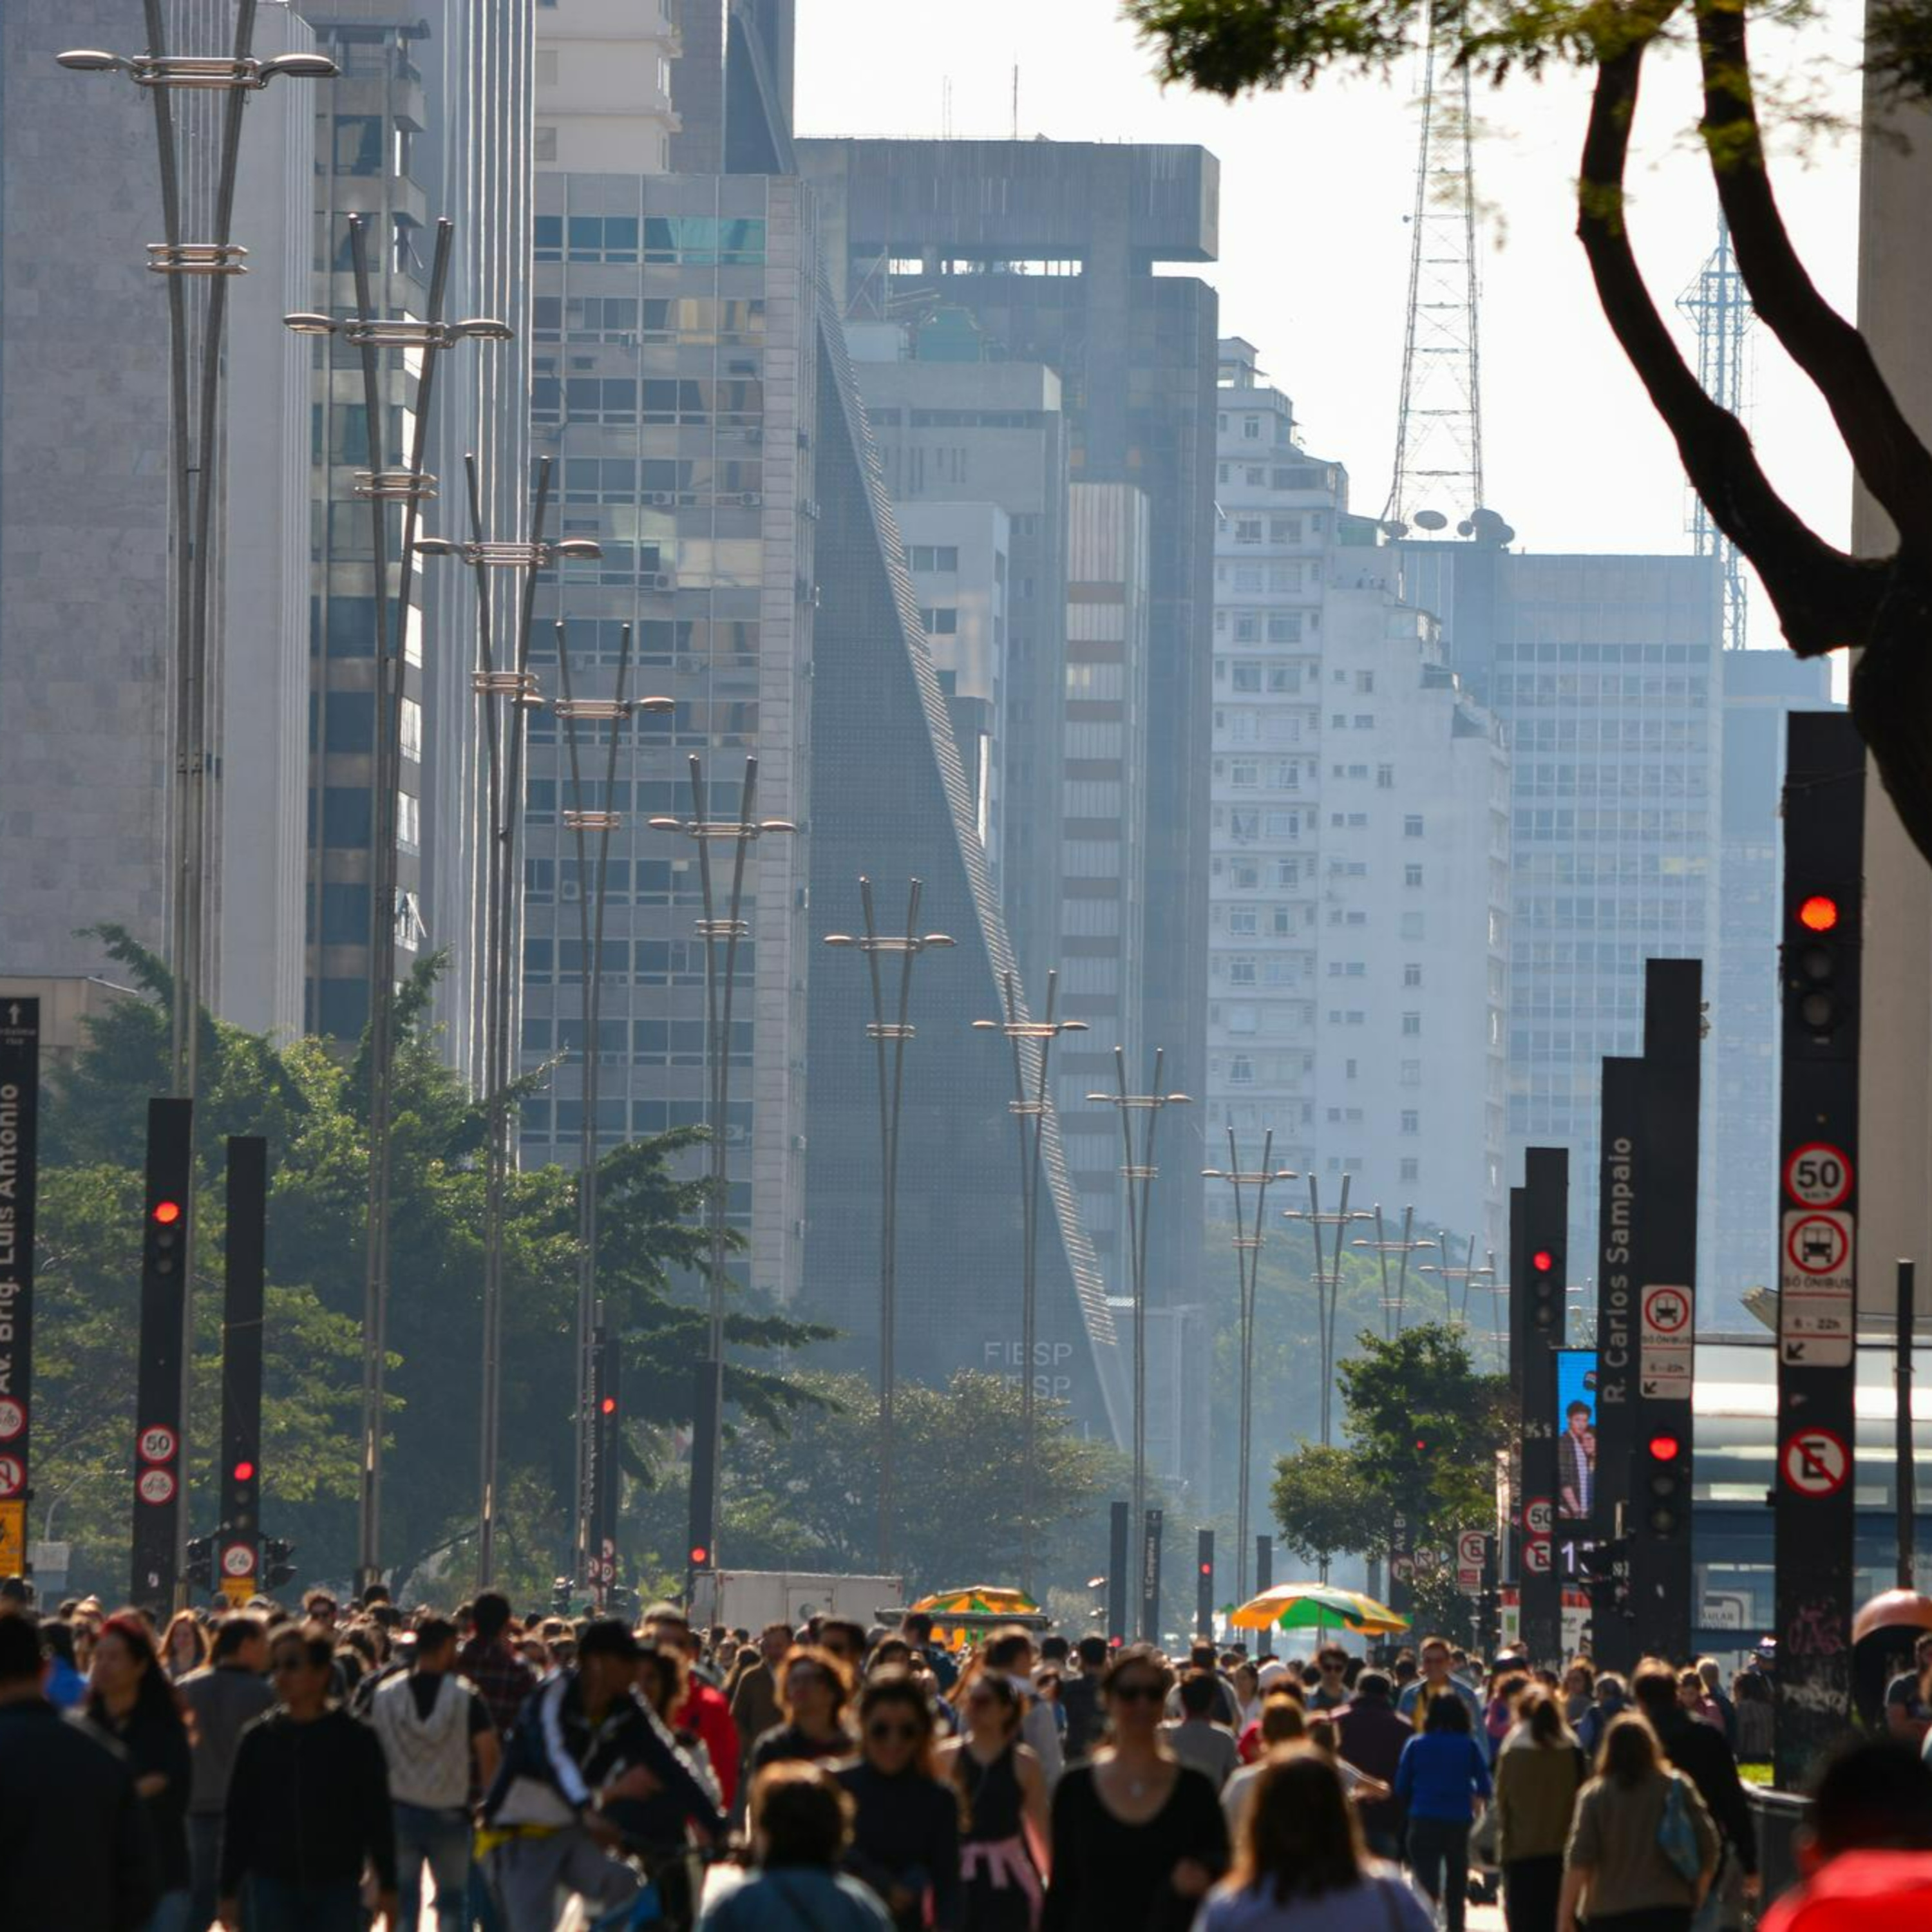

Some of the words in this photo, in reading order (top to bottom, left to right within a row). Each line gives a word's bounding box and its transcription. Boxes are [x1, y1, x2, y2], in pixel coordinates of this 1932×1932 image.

[1797, 1160, 1840, 1189] 50
[1606, 1137, 1634, 1264] Sampaio
[0, 1276, 20, 1341] Brig.
[1605, 1274, 1628, 1368] Carlos
[984, 1341, 1073, 1366] FIESP
[1603, 1377, 1626, 1403] R.
[146, 1434, 171, 1452] 50
